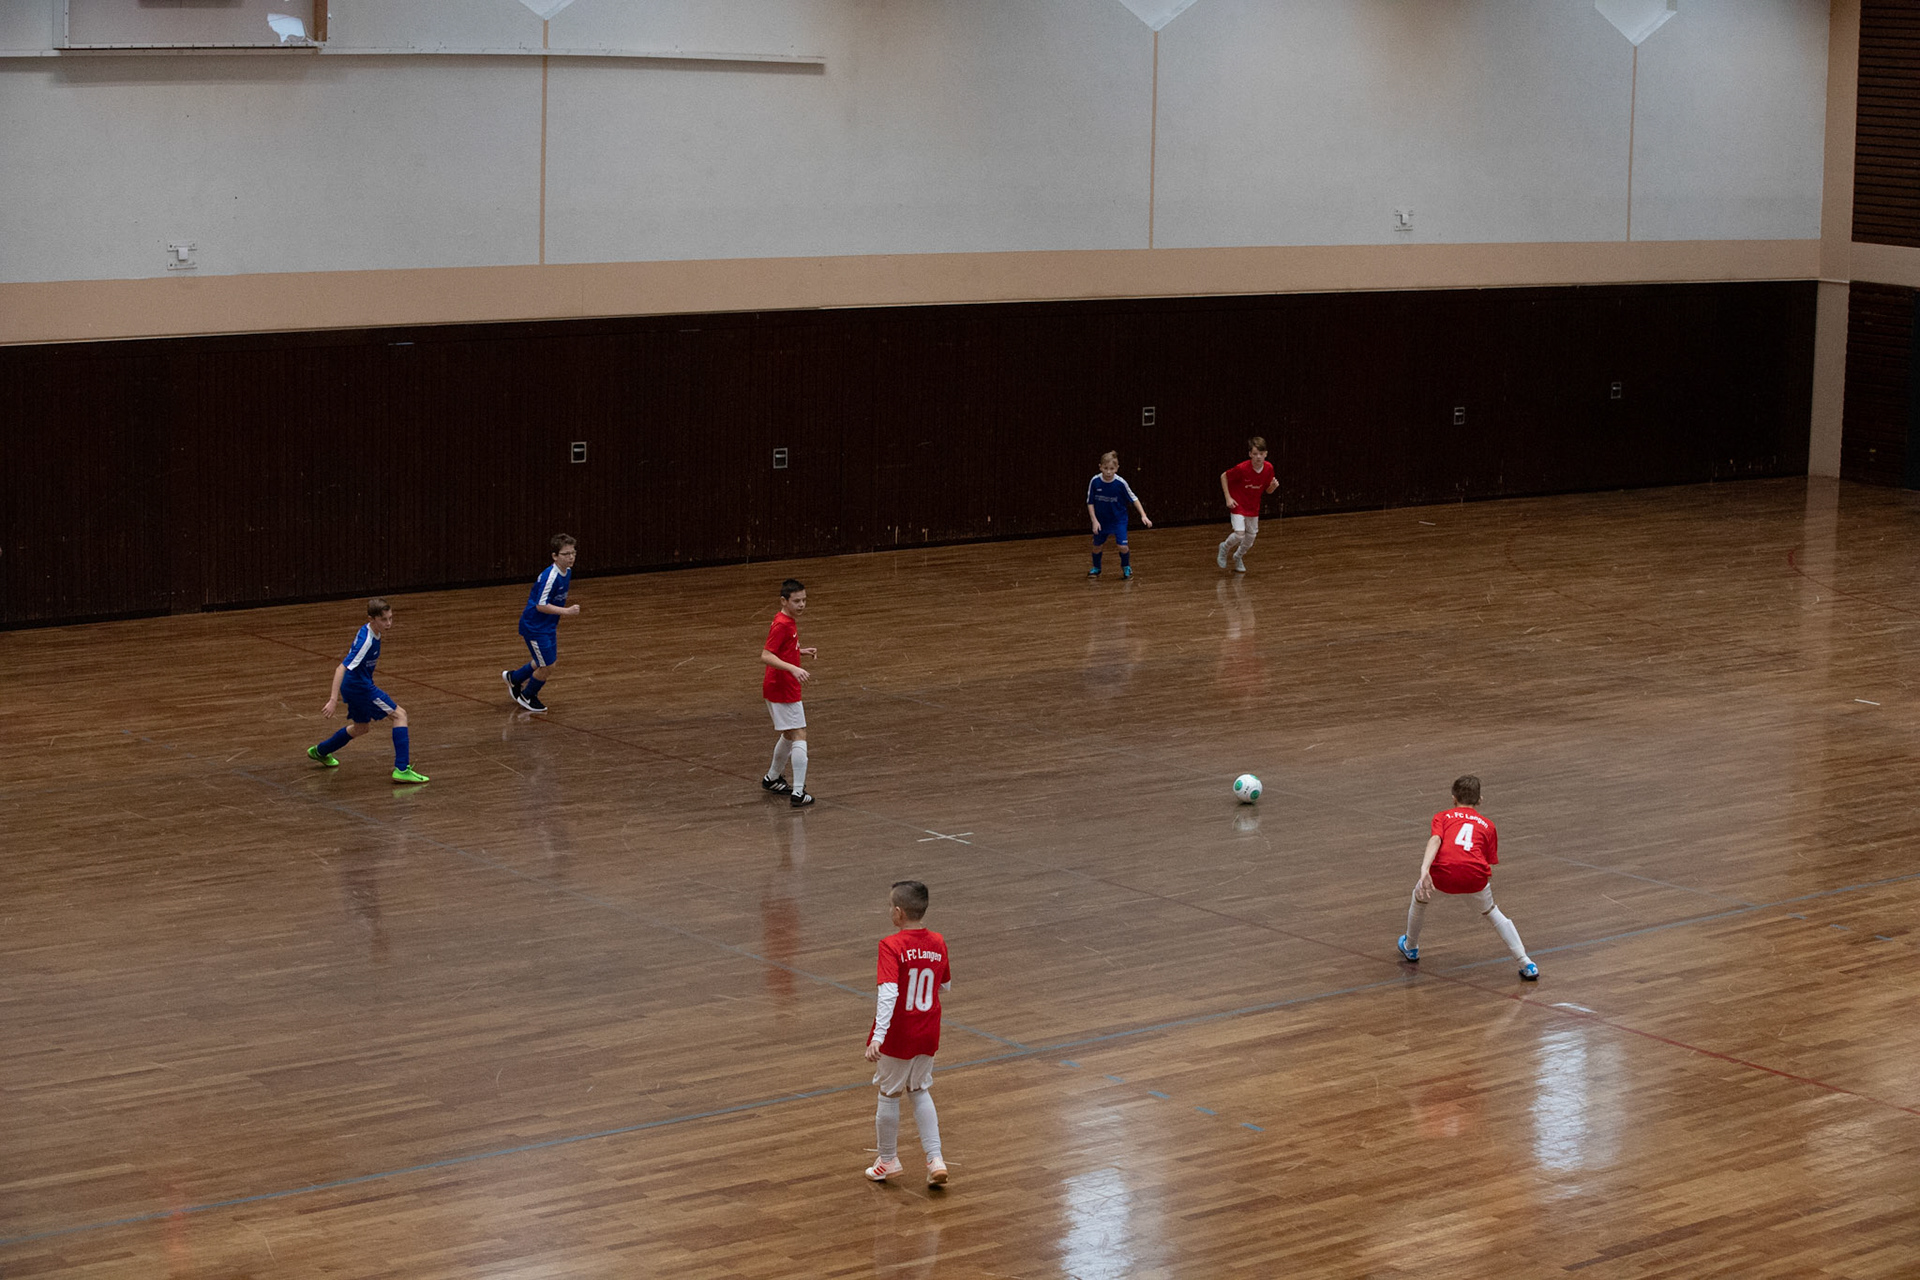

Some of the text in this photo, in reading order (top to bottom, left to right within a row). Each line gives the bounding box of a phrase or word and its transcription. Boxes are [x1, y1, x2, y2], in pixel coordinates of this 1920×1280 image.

[1455, 823, 1474, 851] 4
[907, 949, 917, 960] FC
[918, 948, 942, 962] Langen
[905, 968, 935, 1011] 10
